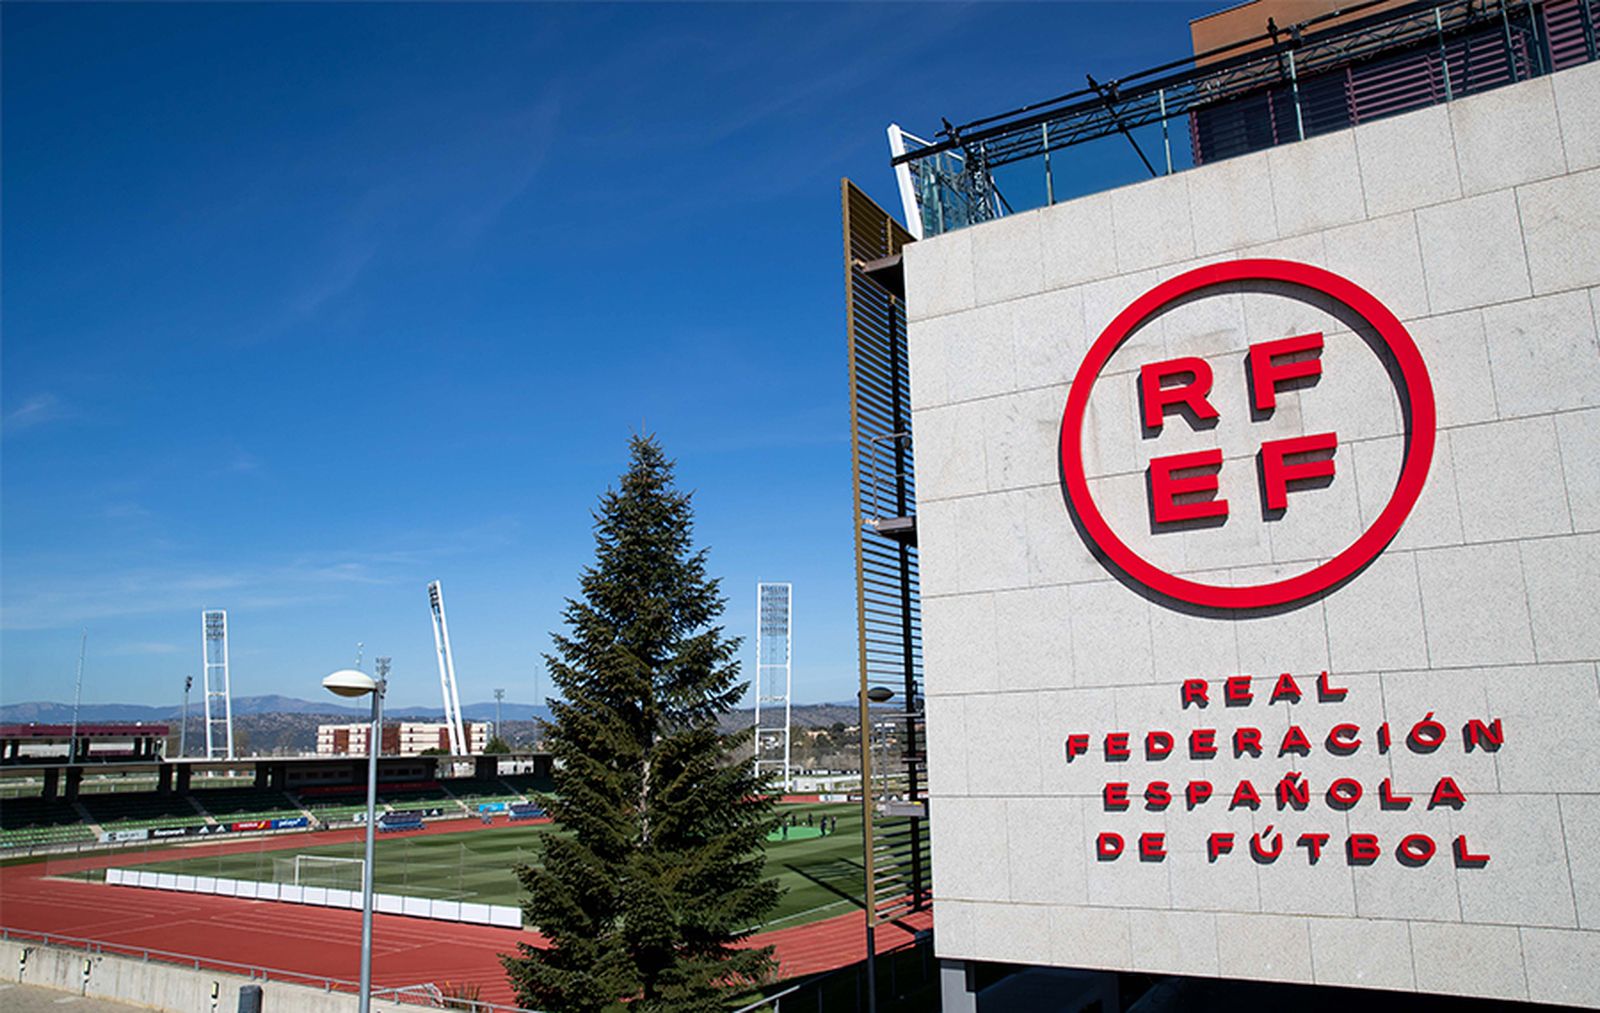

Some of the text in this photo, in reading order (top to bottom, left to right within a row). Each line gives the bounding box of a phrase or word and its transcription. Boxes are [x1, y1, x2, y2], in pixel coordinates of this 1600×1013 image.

[1182, 671, 1349, 705] REAL
[1067, 712, 1505, 760] FEDERACIÓN
[1104, 771, 1467, 808] ESPAÑOLA
[1097, 825, 1491, 865] DE FÚTBOL
